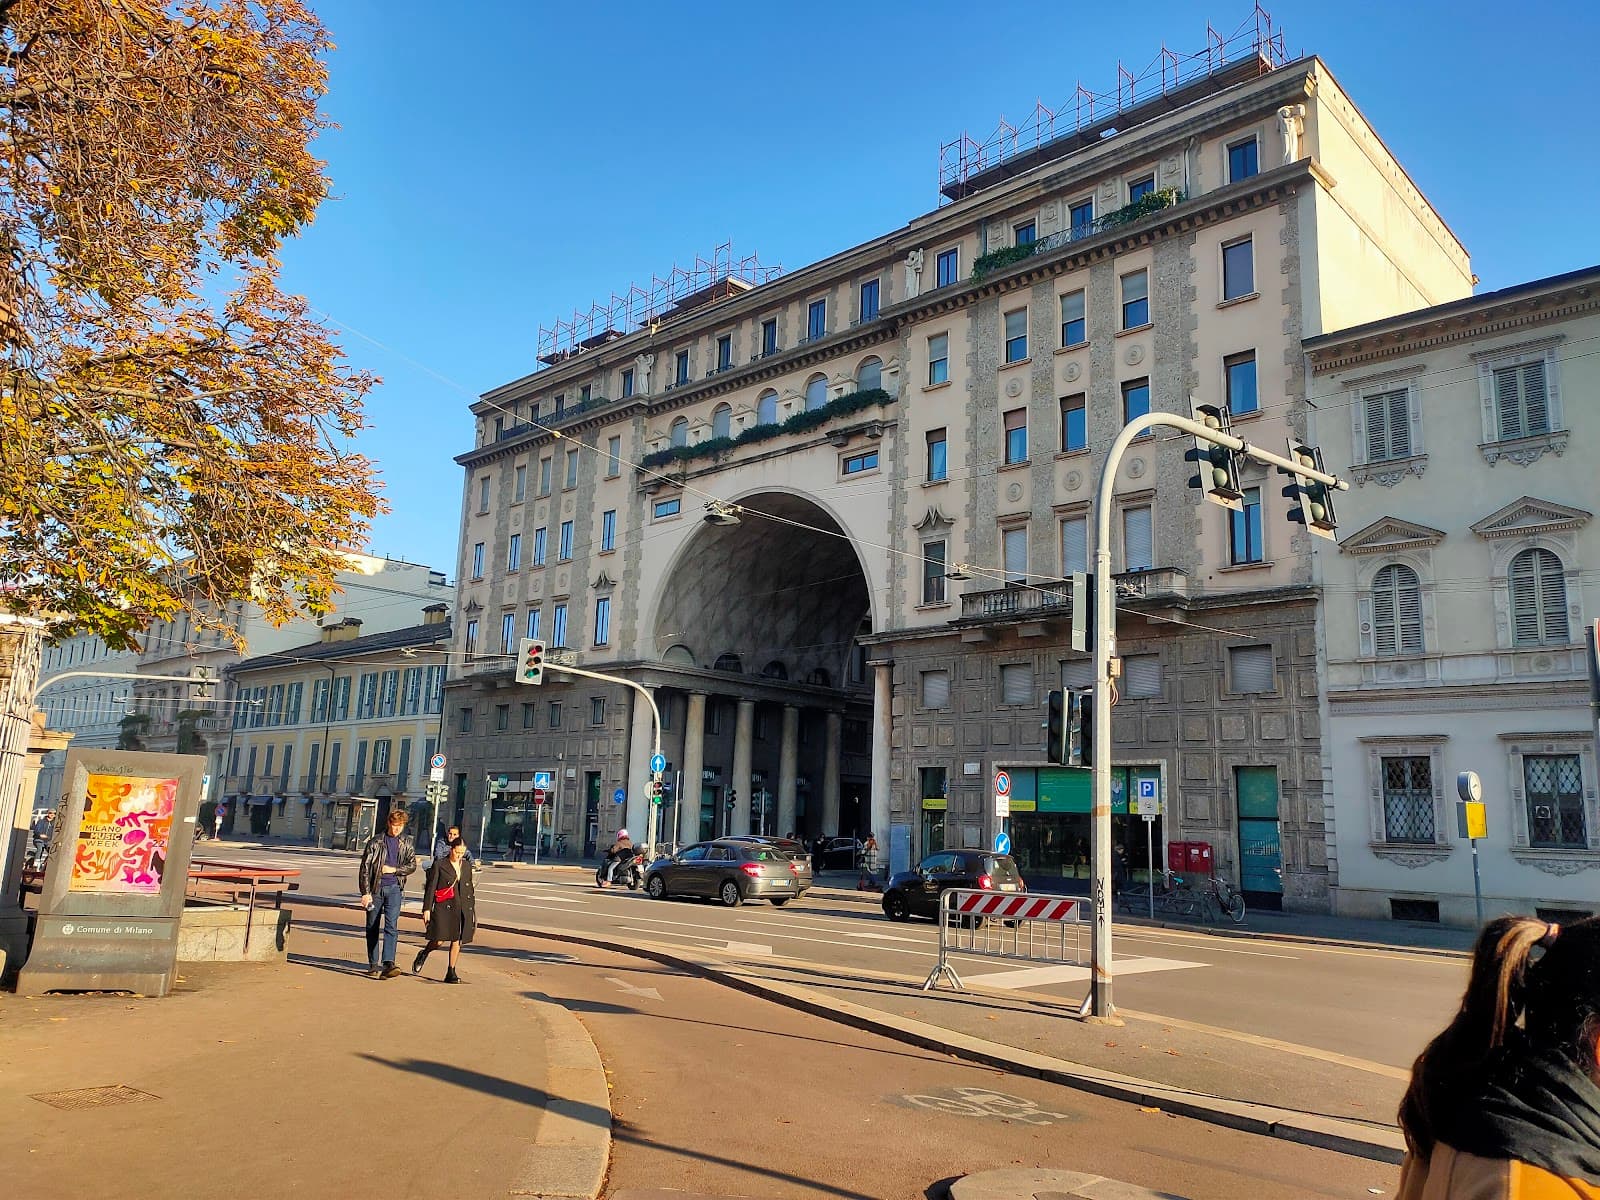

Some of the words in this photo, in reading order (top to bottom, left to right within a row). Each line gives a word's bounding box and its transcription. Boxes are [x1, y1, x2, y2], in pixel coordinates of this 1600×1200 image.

[1142, 782, 1152, 796] P
[84, 825, 121, 833] MILANO
[90, 832, 122, 840] MUSIC
[76, 925, 111, 933] Comune
[113, 925, 122, 934] di
[124, 926, 153, 934] Milano
